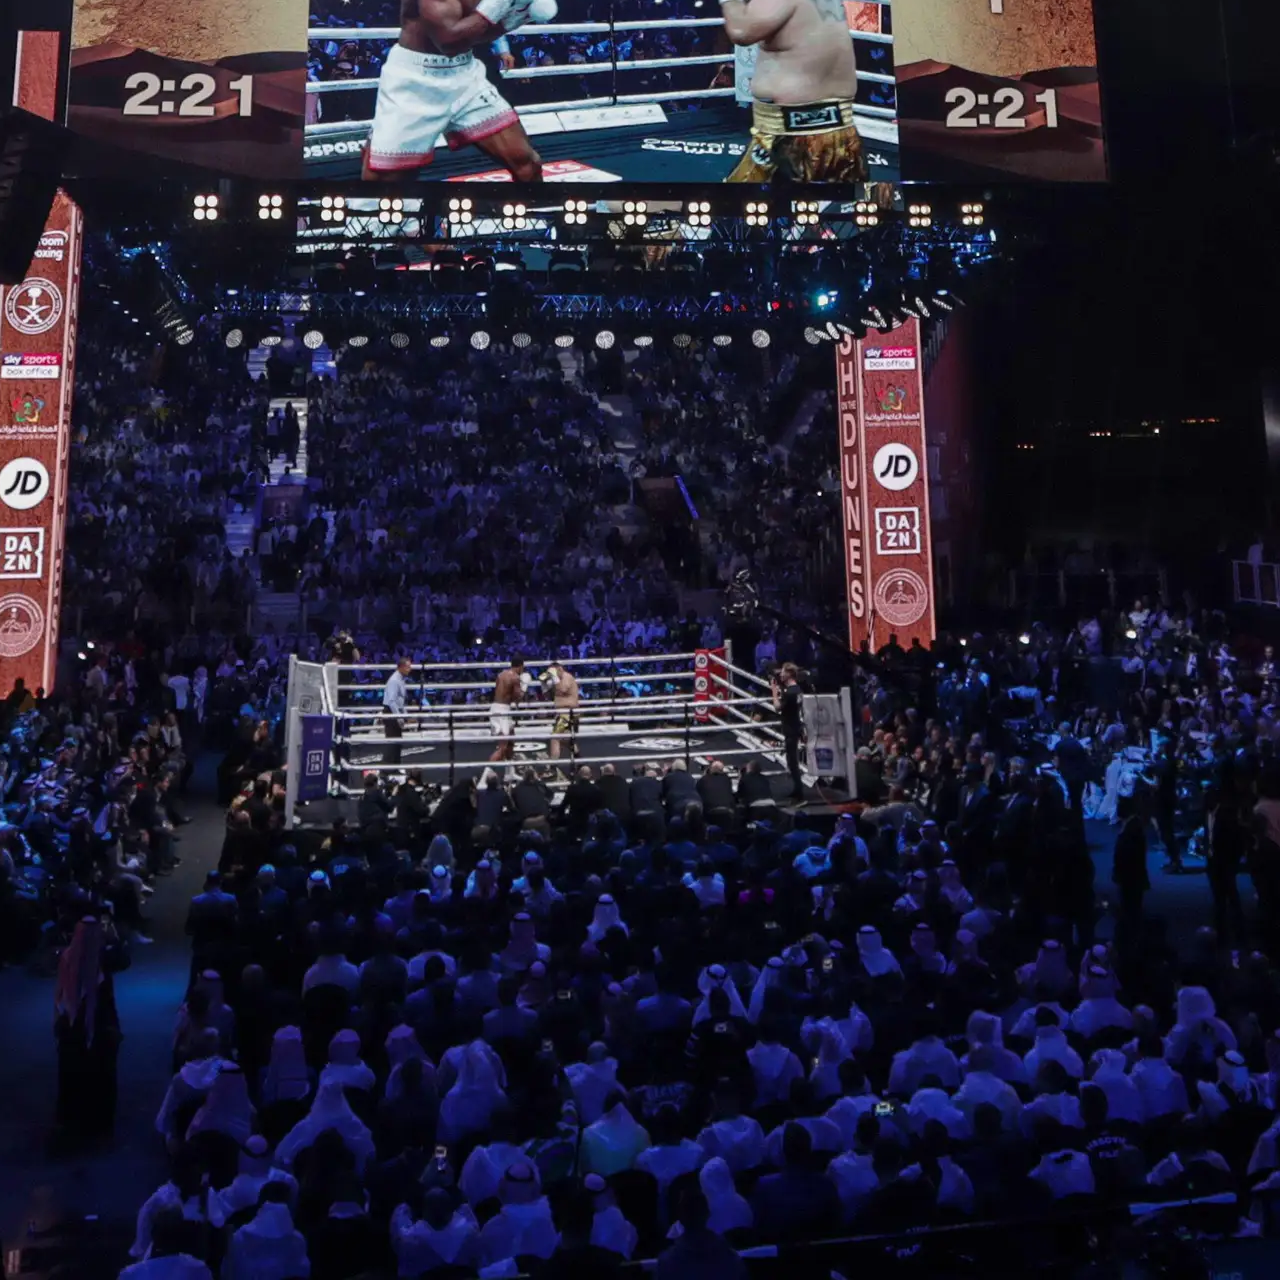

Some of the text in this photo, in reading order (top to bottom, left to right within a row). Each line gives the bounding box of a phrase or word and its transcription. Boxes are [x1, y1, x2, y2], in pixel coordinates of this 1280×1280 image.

[123, 72, 253, 117] 2:21
[945, 87, 1058, 128] 2:21
[3, 354, 57, 366] sky sports
[866, 348, 914, 358] sky sports
[879, 455, 911, 478] JD
[4, 470, 42, 495] JD
[842, 414, 865, 618] DUNES
